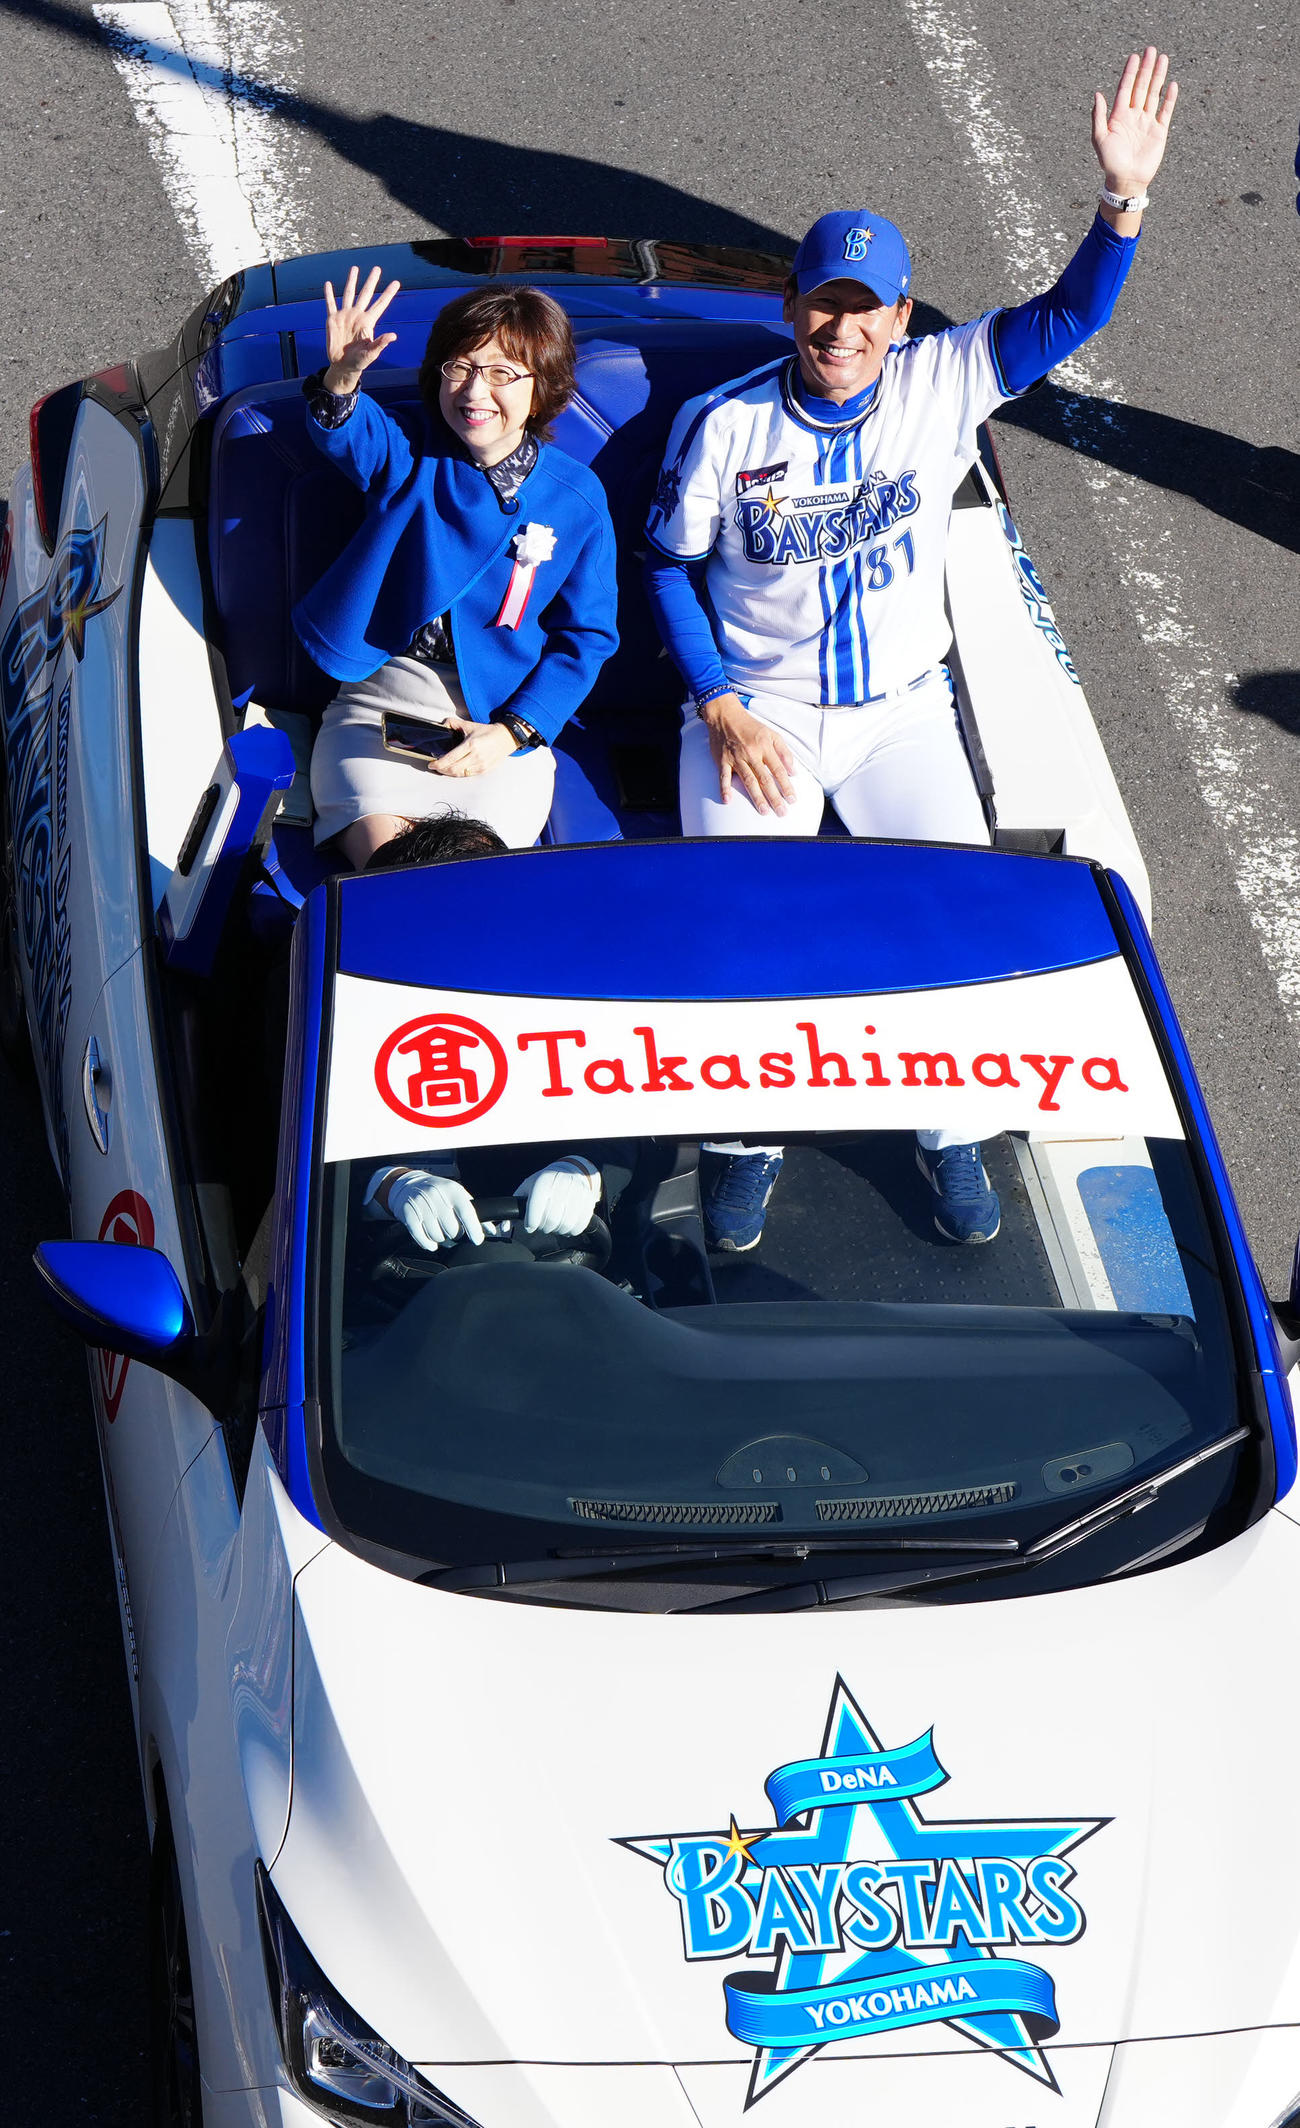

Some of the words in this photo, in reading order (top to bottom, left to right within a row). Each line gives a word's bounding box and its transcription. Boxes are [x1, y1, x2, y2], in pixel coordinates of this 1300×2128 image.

[843, 227, 868, 261] B
[734, 470, 921, 565] BAYSTARS
[792, 492, 849, 508] YOKOHAMA
[866, 527, 915, 591] 81
[57, 672, 73, 853] YOKOHAMA
[517, 1022, 1130, 1111] Takashimaya
[819, 1764, 899, 1793] DeNA
[664, 1836, 1087, 1961] BAYSTARS
[804, 1976, 978, 2030] YOKOHAMA
